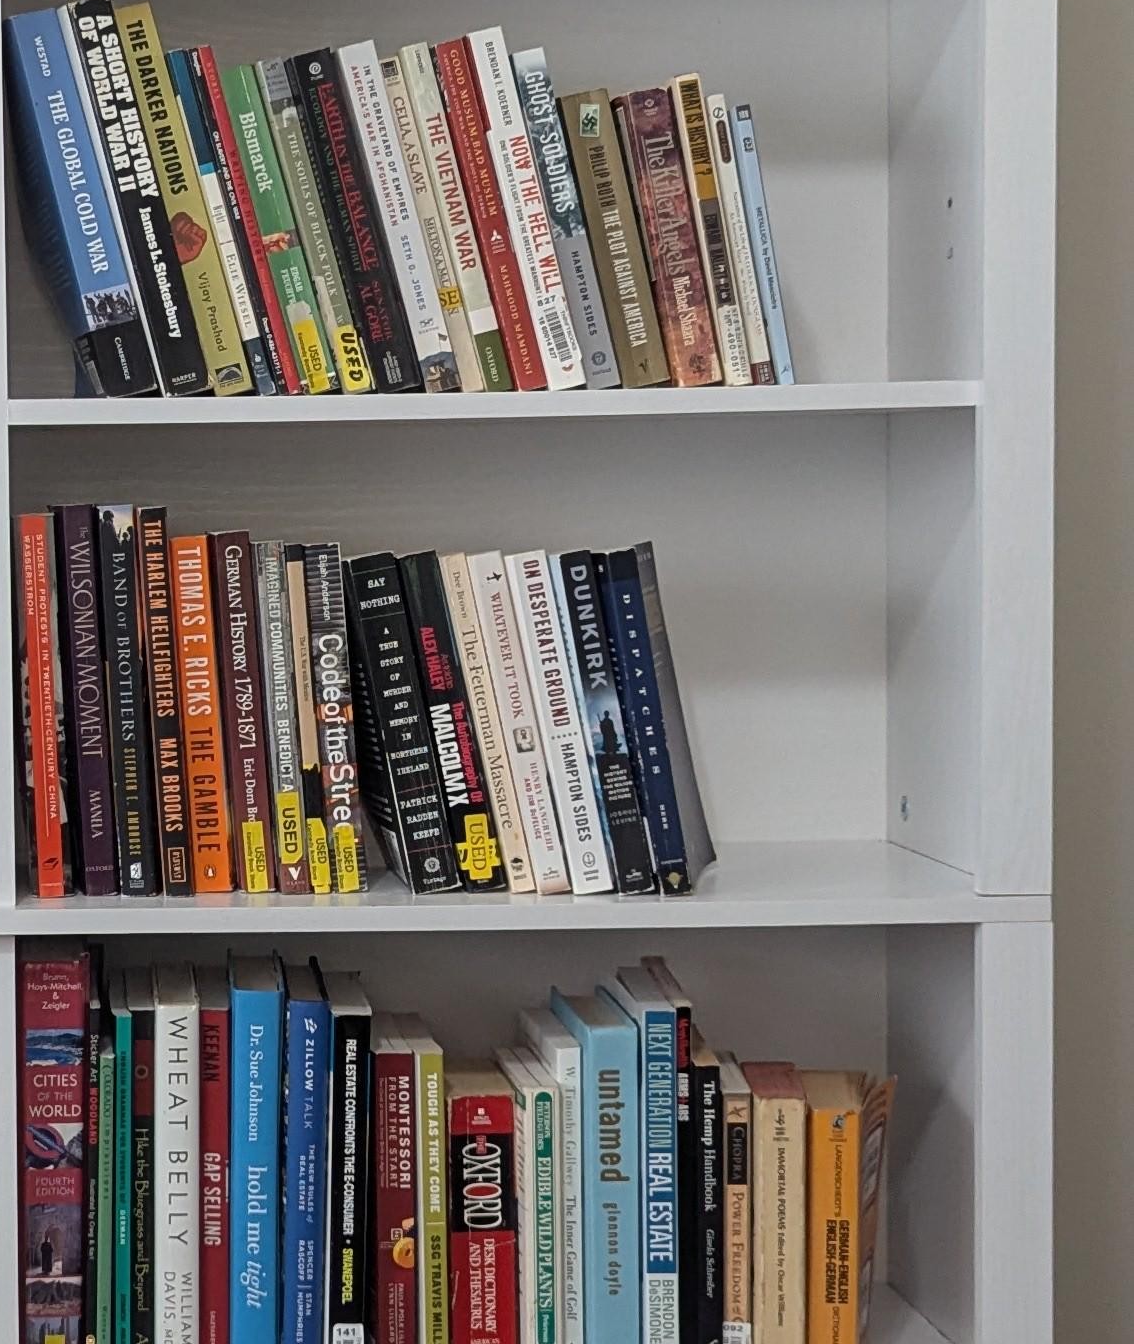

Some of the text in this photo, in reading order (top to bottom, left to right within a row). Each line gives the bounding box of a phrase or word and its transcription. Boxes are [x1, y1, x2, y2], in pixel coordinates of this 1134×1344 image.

[33, 36, 51, 78] WESTAD
[127, 20, 188, 195] THE DARKER NATIONS
[49, 90, 109, 275] THE GLOBAL COLD WAR
[238, 111, 273, 194] Bismarck
[572, 251, 597, 336] HAMPTON SIDES
[602, 208, 648, 348] THE PLOT AGAINST AMERICA
[340, 332, 363, 381] USED
[176, 545, 211, 717] THOMAS E. RICKS
[361, 594, 401, 610] NOTHING
[368, 578, 386, 588] SAY
[570, 564, 608, 689] DUNKIRK
[224, 546, 256, 750] GERMAN HISTORY 1789-1871
[524, 559, 571, 728] ON DESPERATE GROUND
[160, 738, 182, 833] MAX BROOKS
[190, 726, 220, 854] THE GAMBLE
[429, 703, 469, 807] MALCOLM X
[561, 743, 592, 843] HAMPTON SIDES
[281, 807, 298, 854] USED
[29, 1103, 81, 1117] WORLD
[33, 1074, 78, 1088] CITIES
[168, 1016, 189, 1246] WHEAT BELLY
[398, 1075, 411, 1190] MONTESSORI
[597, 1069, 630, 1182] untamed
[647, 1023, 674, 1263] NEXT GENERATION REAL ESTATE
[203, 1152, 222, 1247] GAP SELLING
[240, 1165, 268, 1309] hold me tight
[336, 1327, 356, 1336] 141
